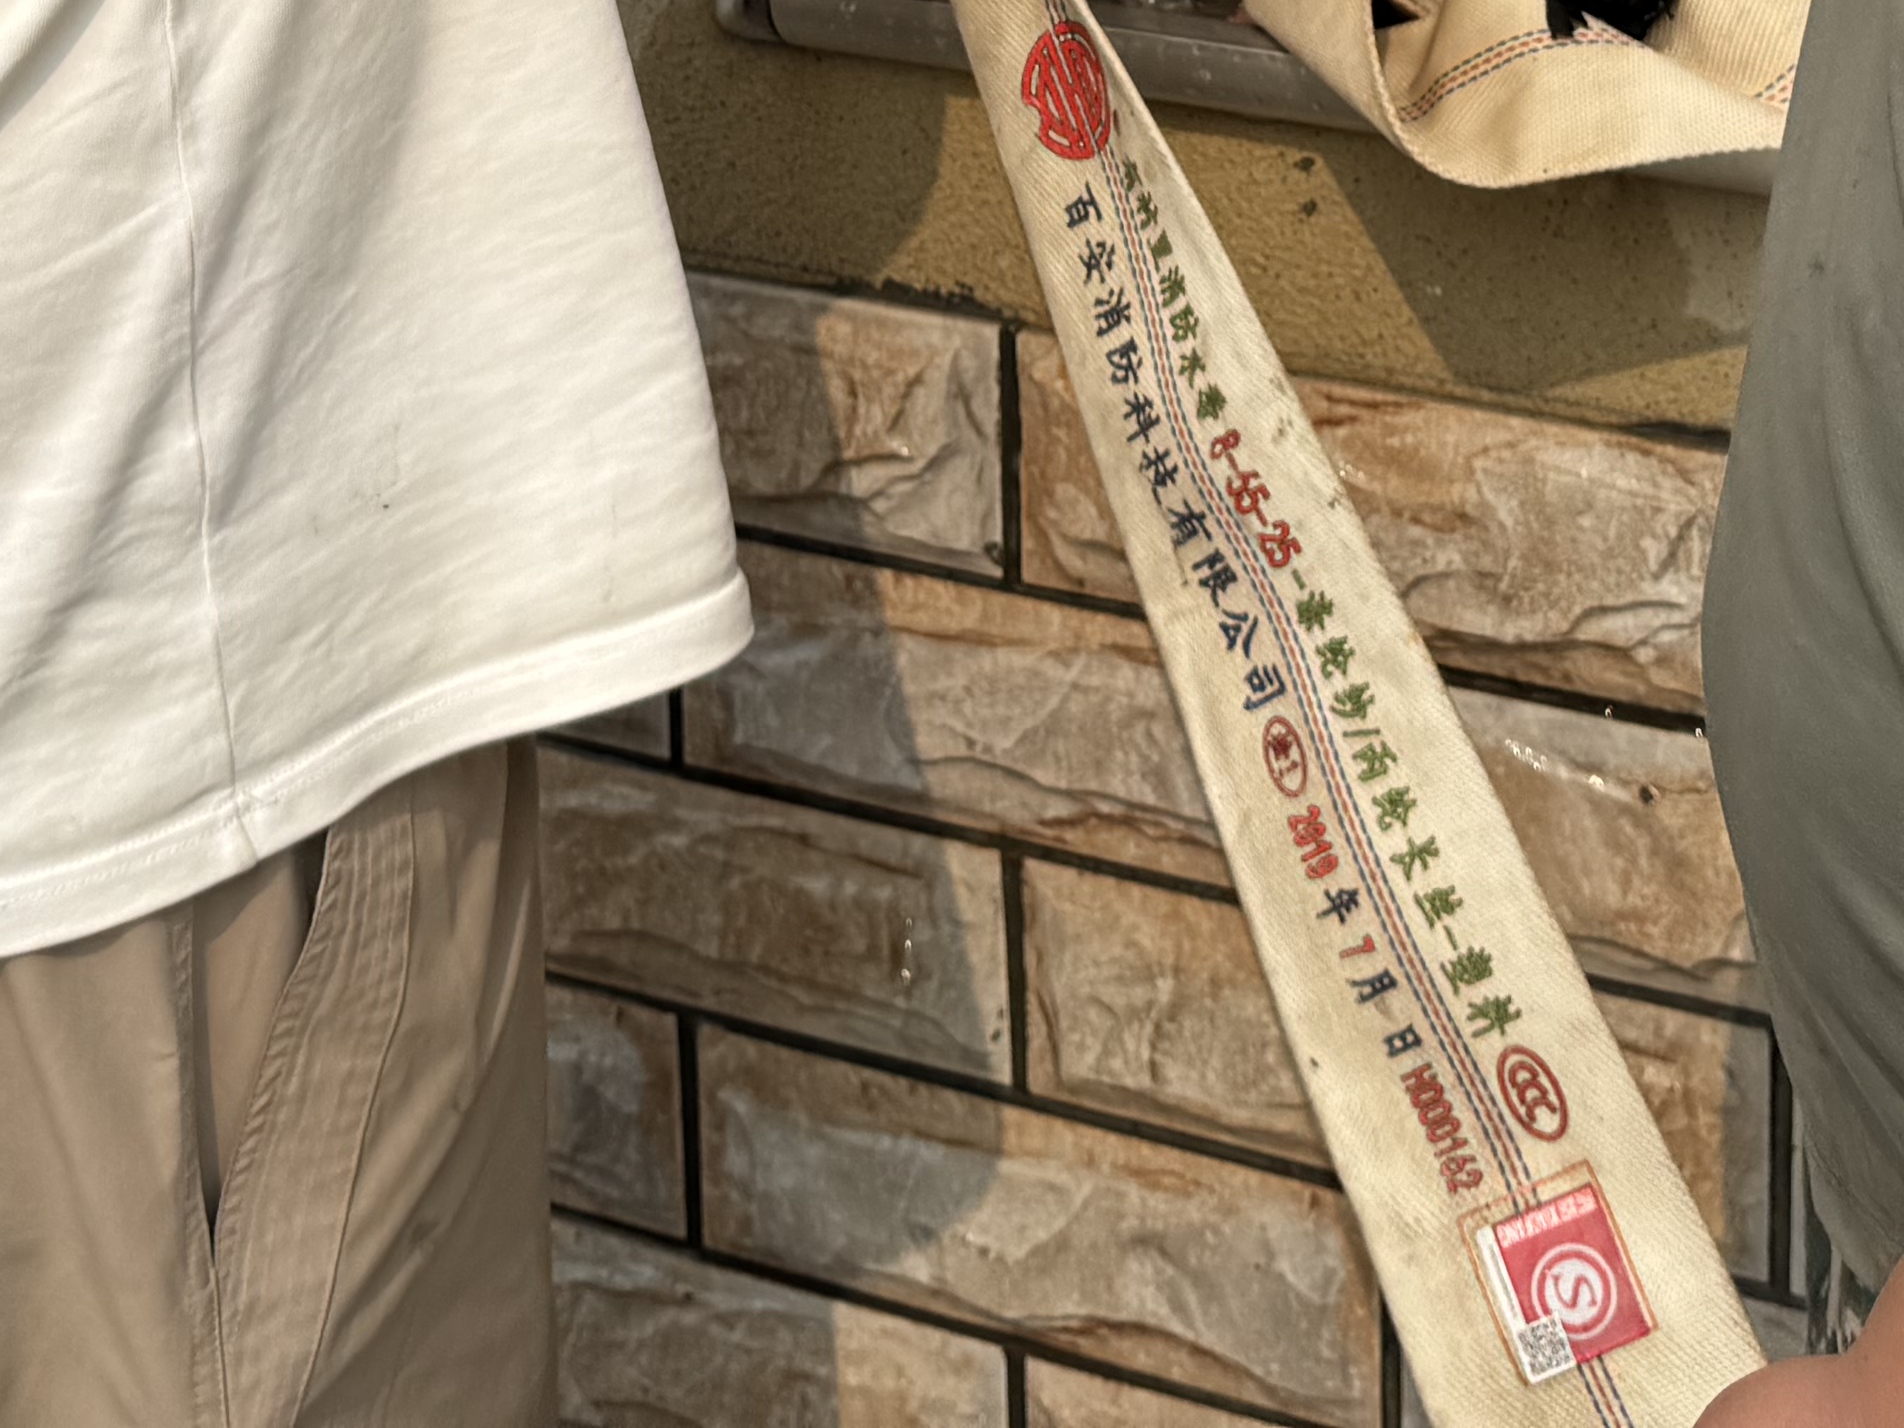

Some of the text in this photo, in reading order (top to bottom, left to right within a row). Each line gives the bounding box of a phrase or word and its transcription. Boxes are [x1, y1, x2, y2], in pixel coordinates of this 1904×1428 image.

[1064, 181, 1287, 712] 百安消防科技有限公司
